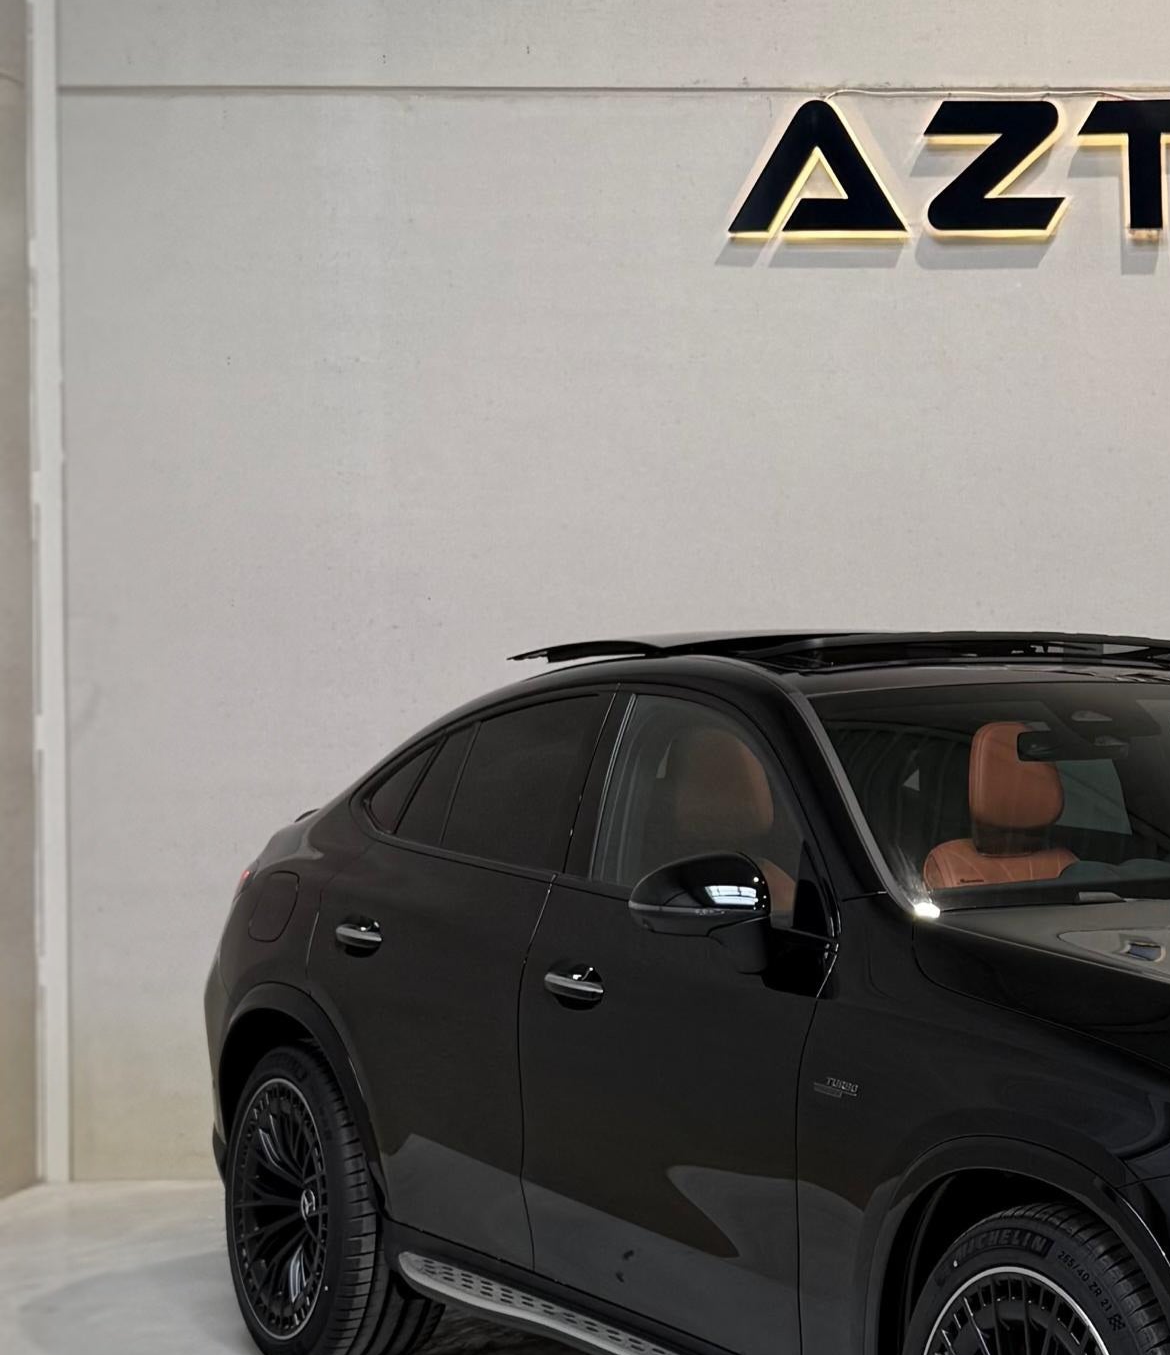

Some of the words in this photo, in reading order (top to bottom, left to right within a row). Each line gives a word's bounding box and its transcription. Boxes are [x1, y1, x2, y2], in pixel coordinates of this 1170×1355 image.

[955, 1229, 1047, 1261] MICHELIN
[1088, 1282, 1103, 1297] ZR
[1100, 1298, 1113, 1312] 21
